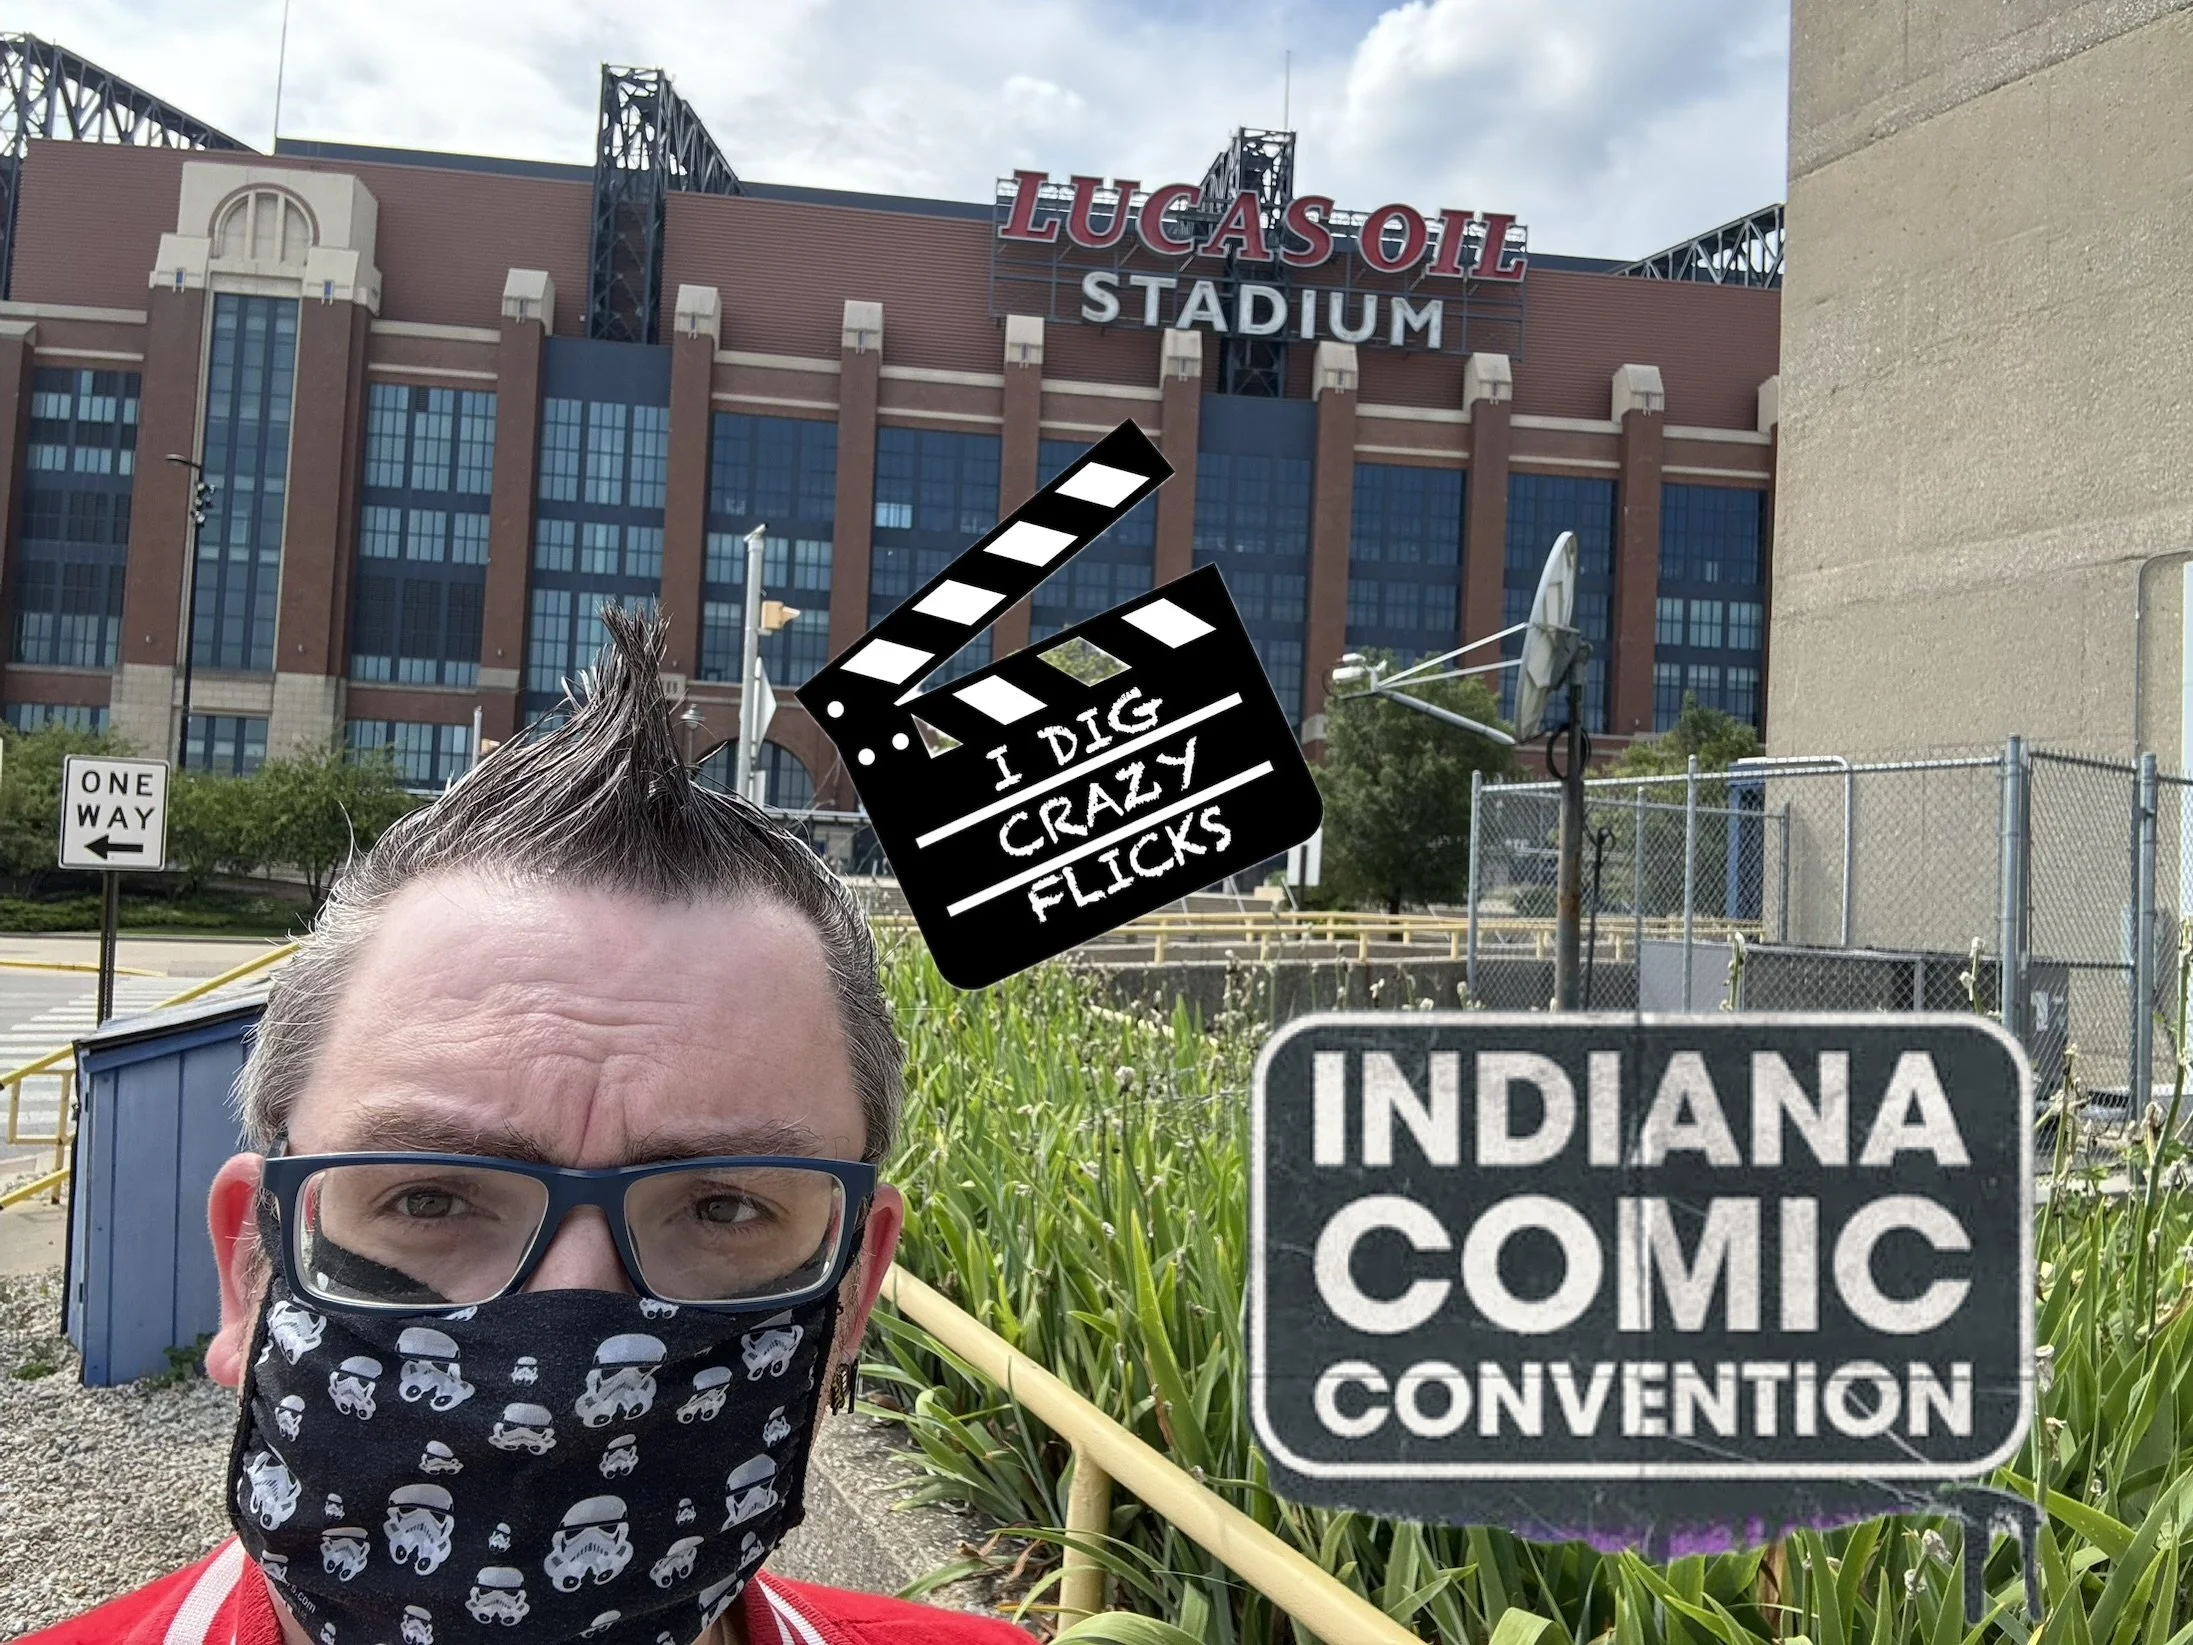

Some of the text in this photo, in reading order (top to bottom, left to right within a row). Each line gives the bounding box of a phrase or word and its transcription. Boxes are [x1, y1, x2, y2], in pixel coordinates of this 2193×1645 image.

[999, 169, 1528, 283] LUCAS OIL
[1081, 271, 1445, 350] STADIUM
[81, 770, 153, 797] ONE
[77, 803, 155, 831] WAY
[287, 1583, 317, 1614] s.com
